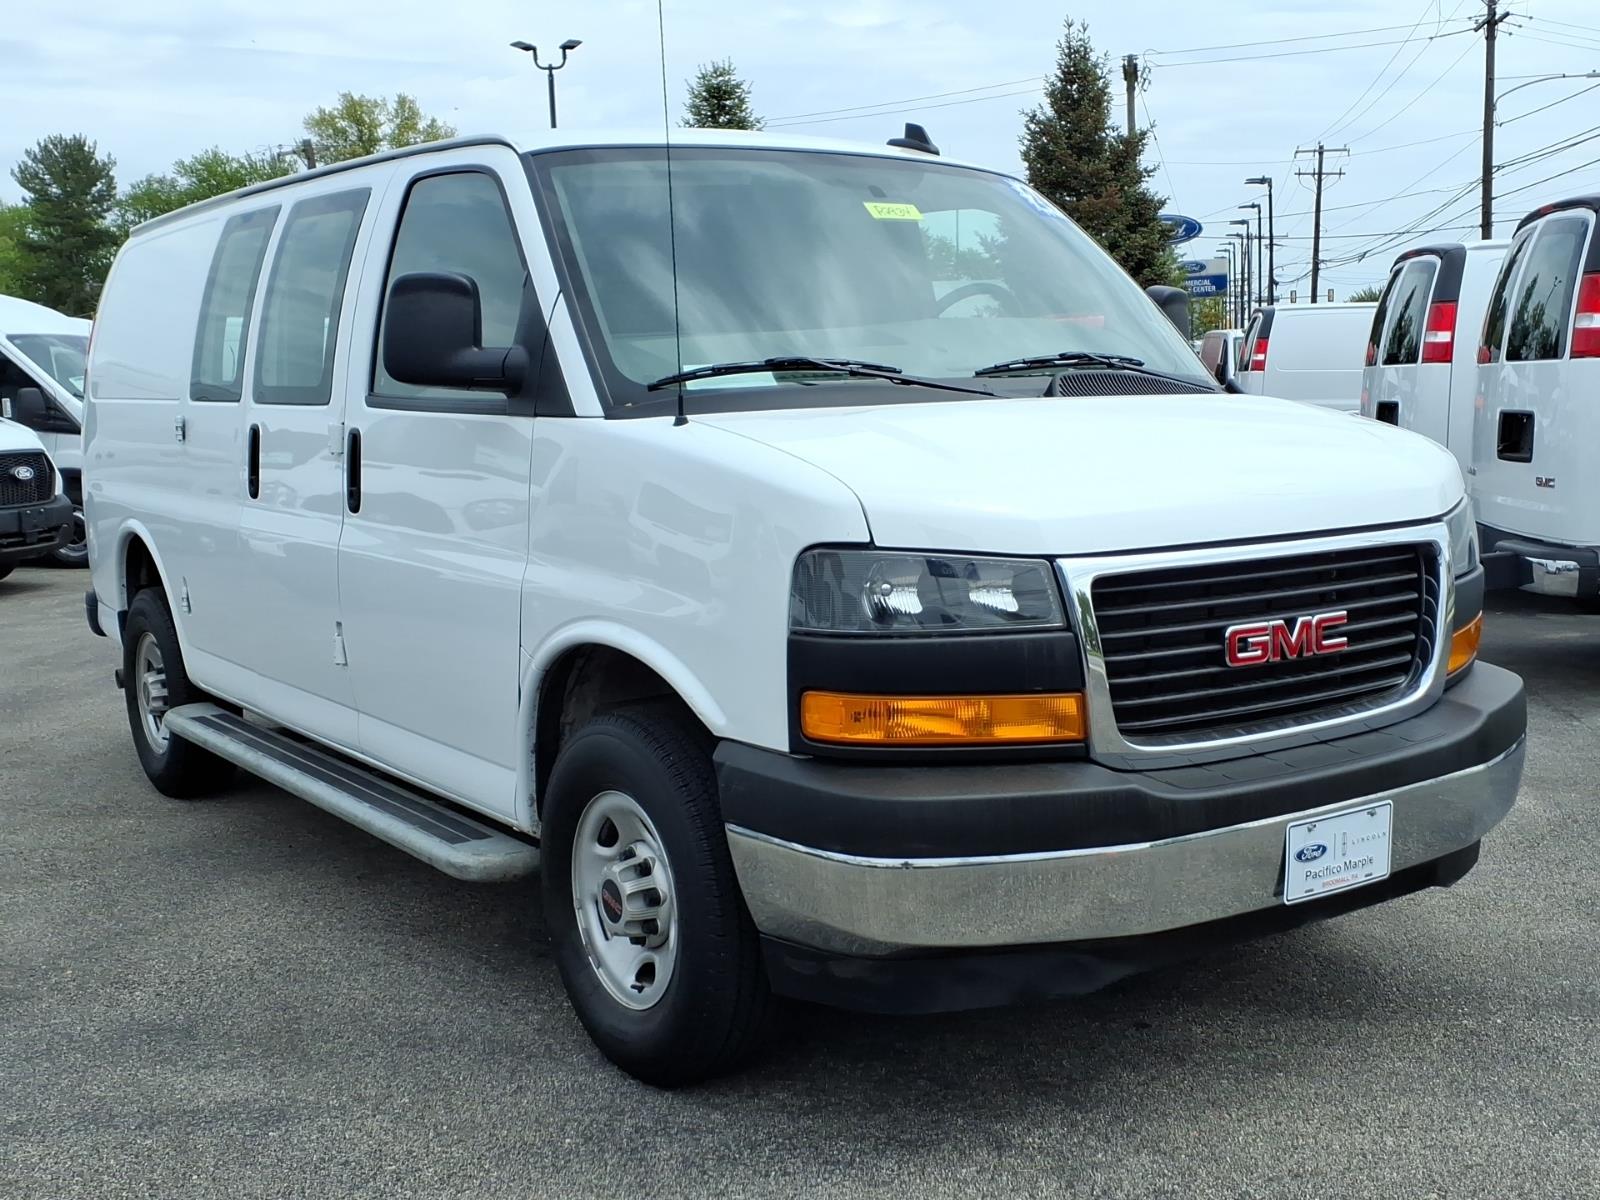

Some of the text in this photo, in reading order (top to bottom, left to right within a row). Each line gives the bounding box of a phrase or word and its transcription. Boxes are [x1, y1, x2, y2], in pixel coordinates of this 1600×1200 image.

[1193, 285, 1216, 293] CENTER
[1536, 476, 1555, 488] GMC
[1225, 609, 1348, 668] GMC
[1351, 831, 1386, 845] LINCOLN
[1301, 845, 1323, 860] Ford
[1305, 855, 1374, 881] Pacifico Marple
